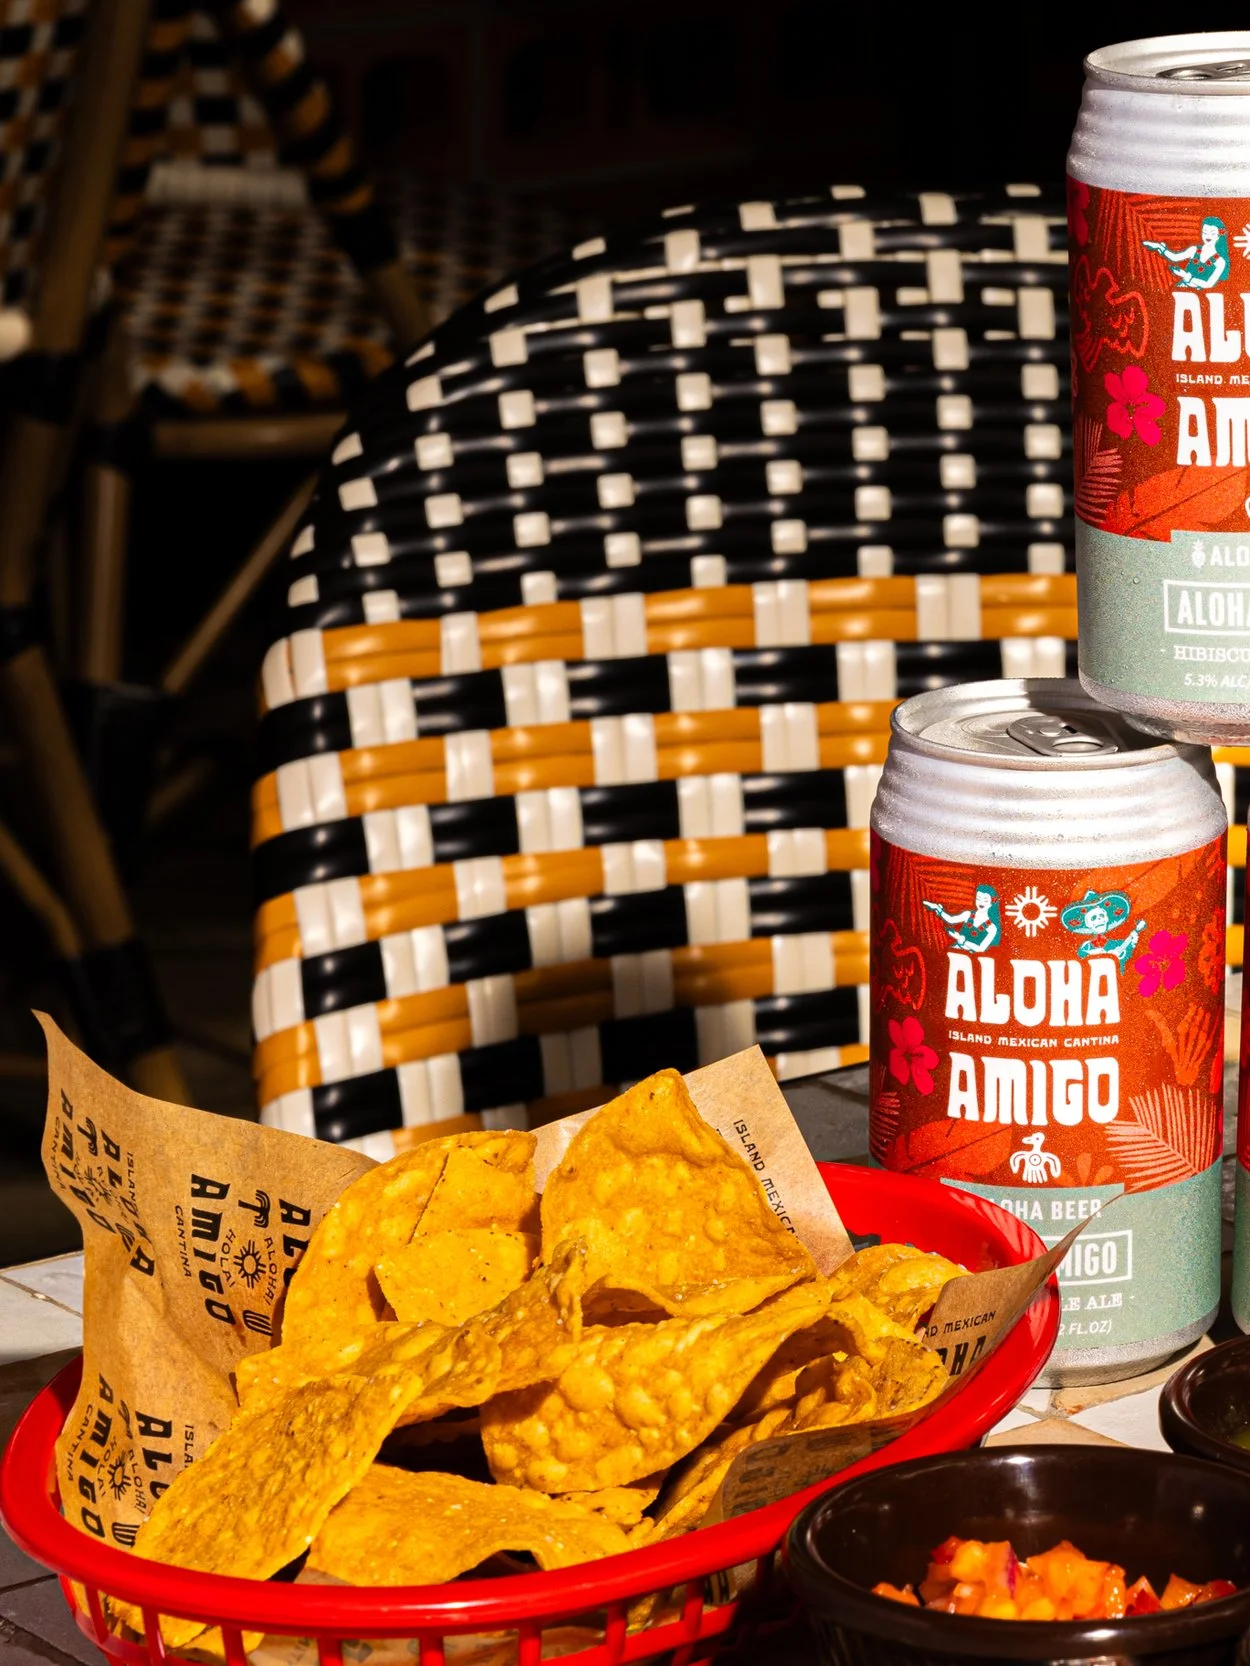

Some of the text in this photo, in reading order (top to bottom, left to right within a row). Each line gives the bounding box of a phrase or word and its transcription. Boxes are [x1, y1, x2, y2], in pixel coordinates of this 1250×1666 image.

[1175, 372, 1223, 386] ISLAND
[1183, 672, 1216, 688] 5.3%
[944, 952, 1121, 1028] ALOHA
[948, 1029, 1120, 1049] ISLAND MEXICAN CANTINA
[947, 1052, 1120, 1126] AMIGO
[733, 1119, 766, 1171] ISLAND
[1052, 1199, 1102, 1220] BEER
[175, 1204, 192, 1278] CANTINA
[191, 1174, 236, 1325] AMIGO
[1056, 1241, 1117, 1277] MIGO
[1084, 1292, 1122, 1310] ALE
[943, 1311, 997, 1335] MEXICAN
[1069, 1319, 1112, 1336] FL.OZ)
[67, 1403, 93, 1482] CANTINA
[78, 1373, 114, 1538] AMIGO
